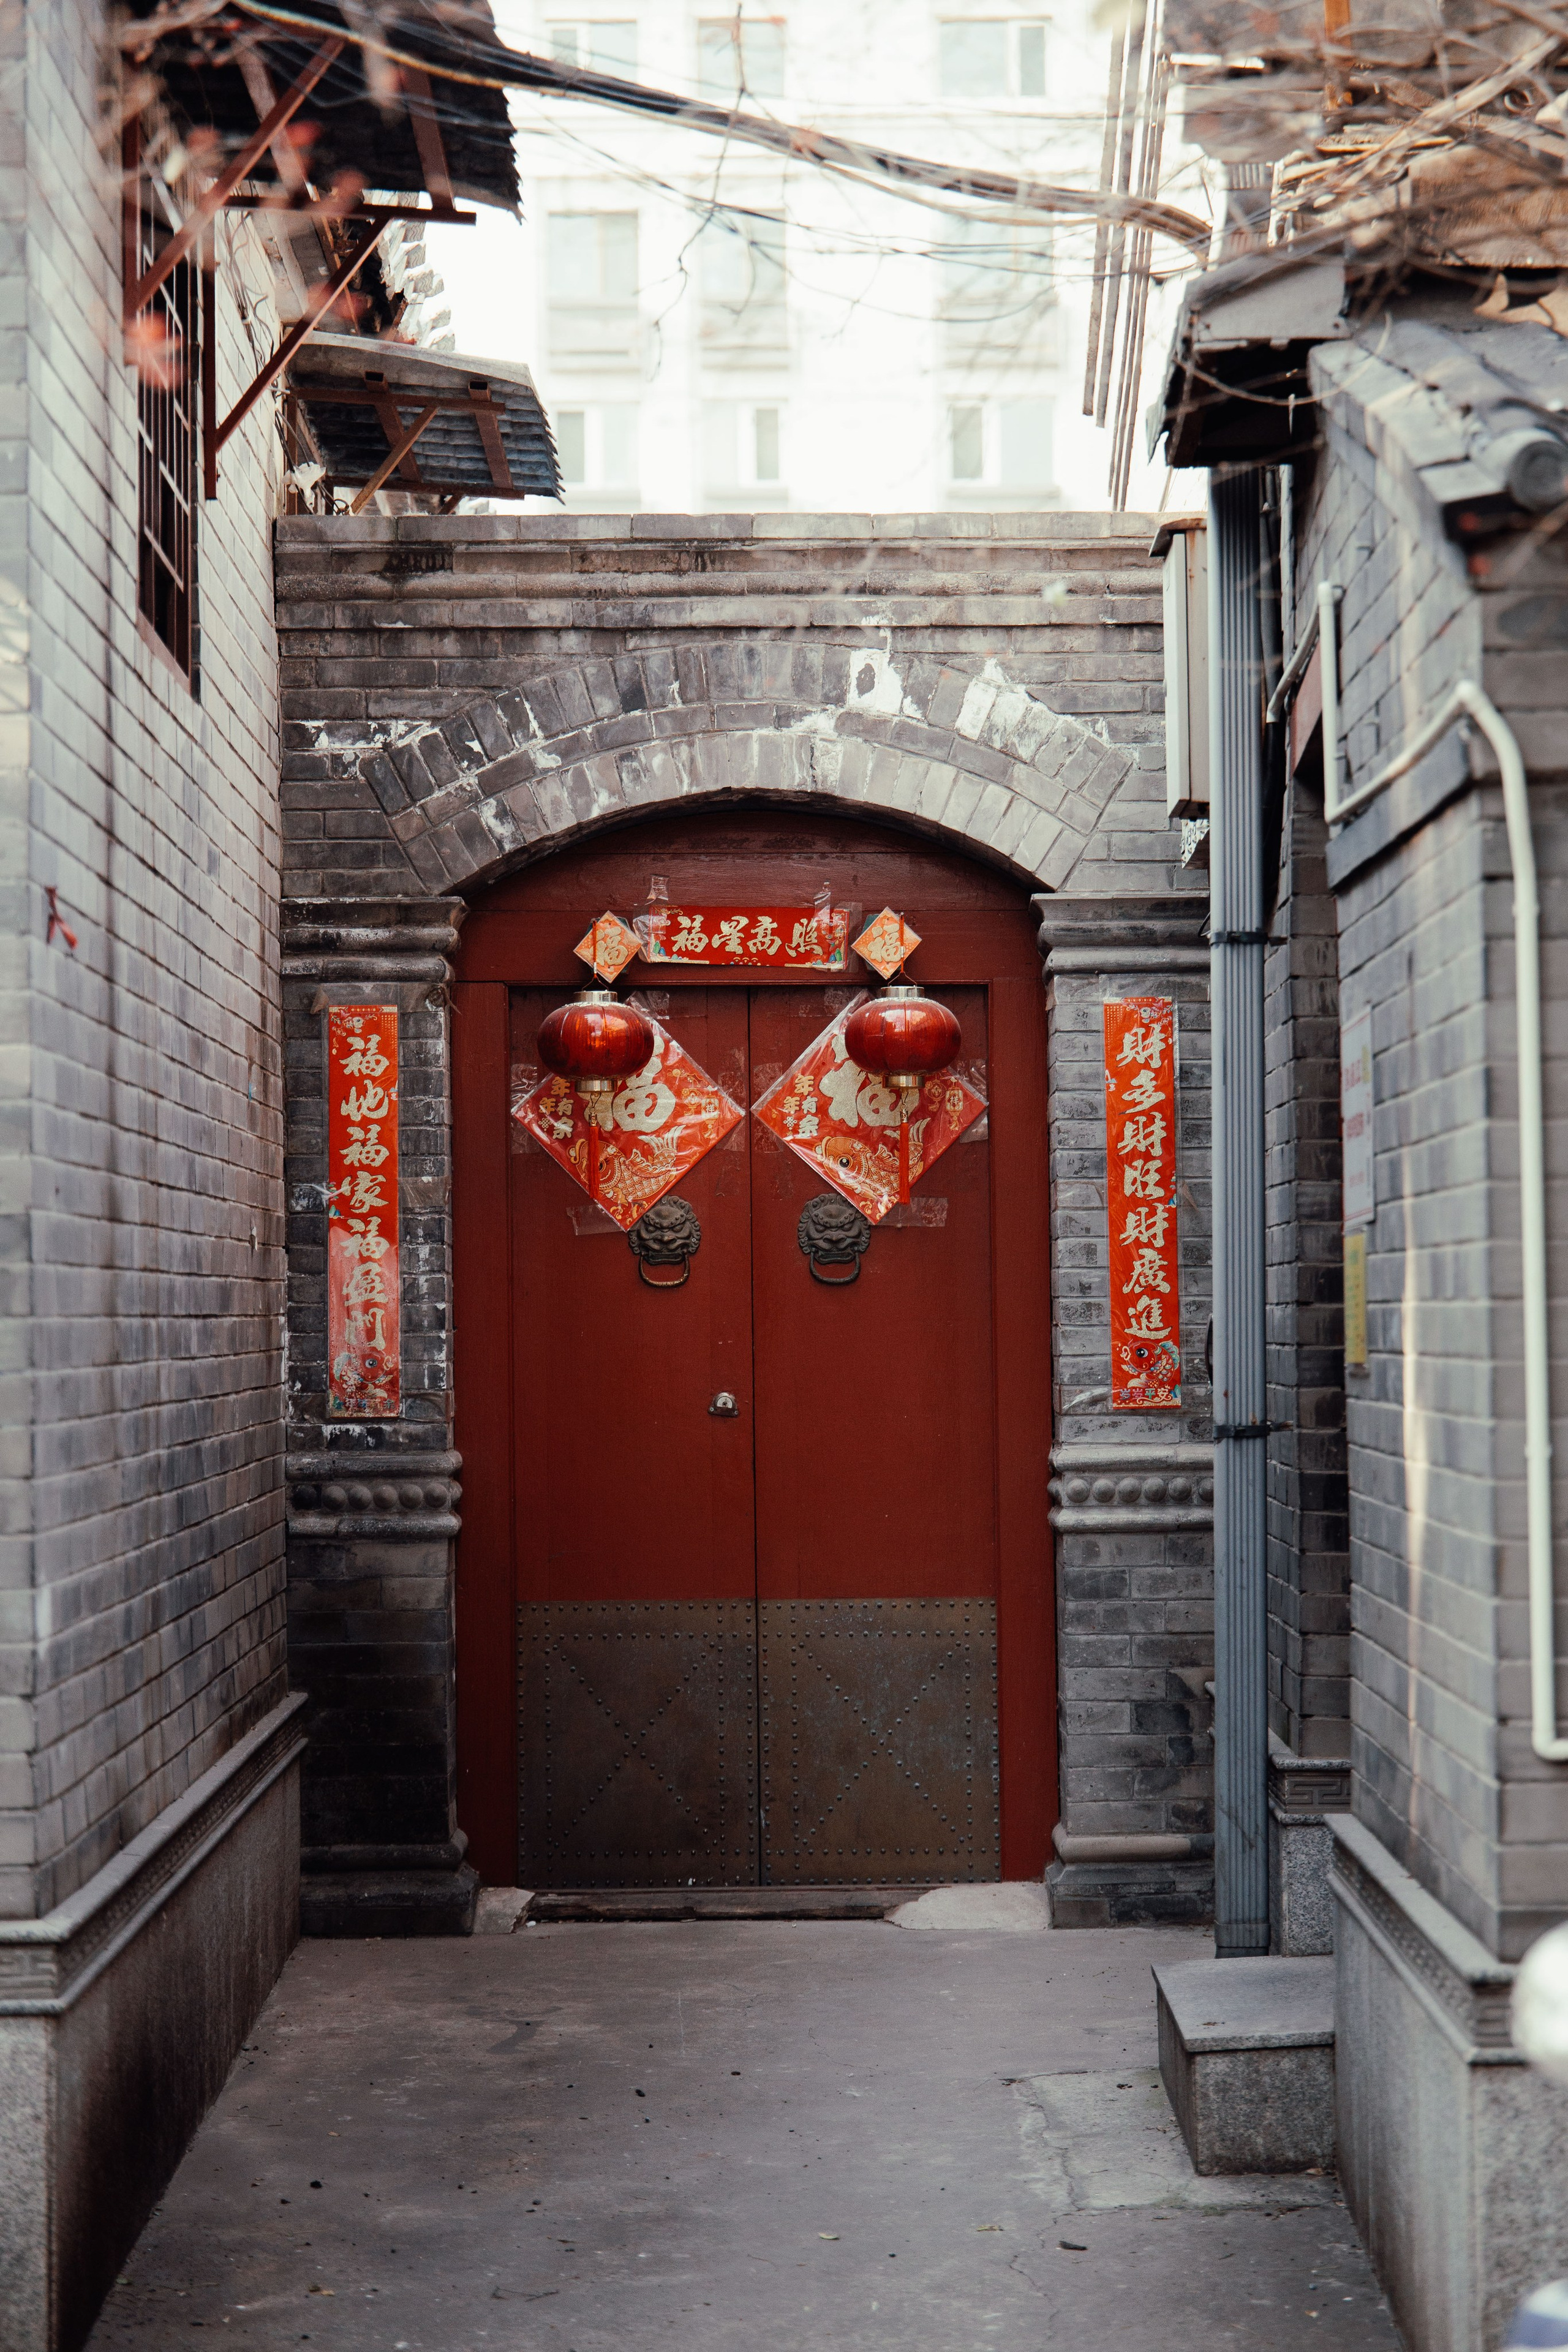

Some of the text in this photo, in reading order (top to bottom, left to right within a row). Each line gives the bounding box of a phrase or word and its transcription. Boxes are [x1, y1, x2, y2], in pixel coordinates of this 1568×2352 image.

[589, 926, 628, 967] 福
[671, 913, 824, 957] 福星高照
[867, 923, 906, 963] 福
[339, 1034, 390, 1351] 福地福家福盈門
[1116, 1023, 1172, 1339] 財多財旺財廣進
[1120, 1388, 1169, 1400] 岁岁平安
